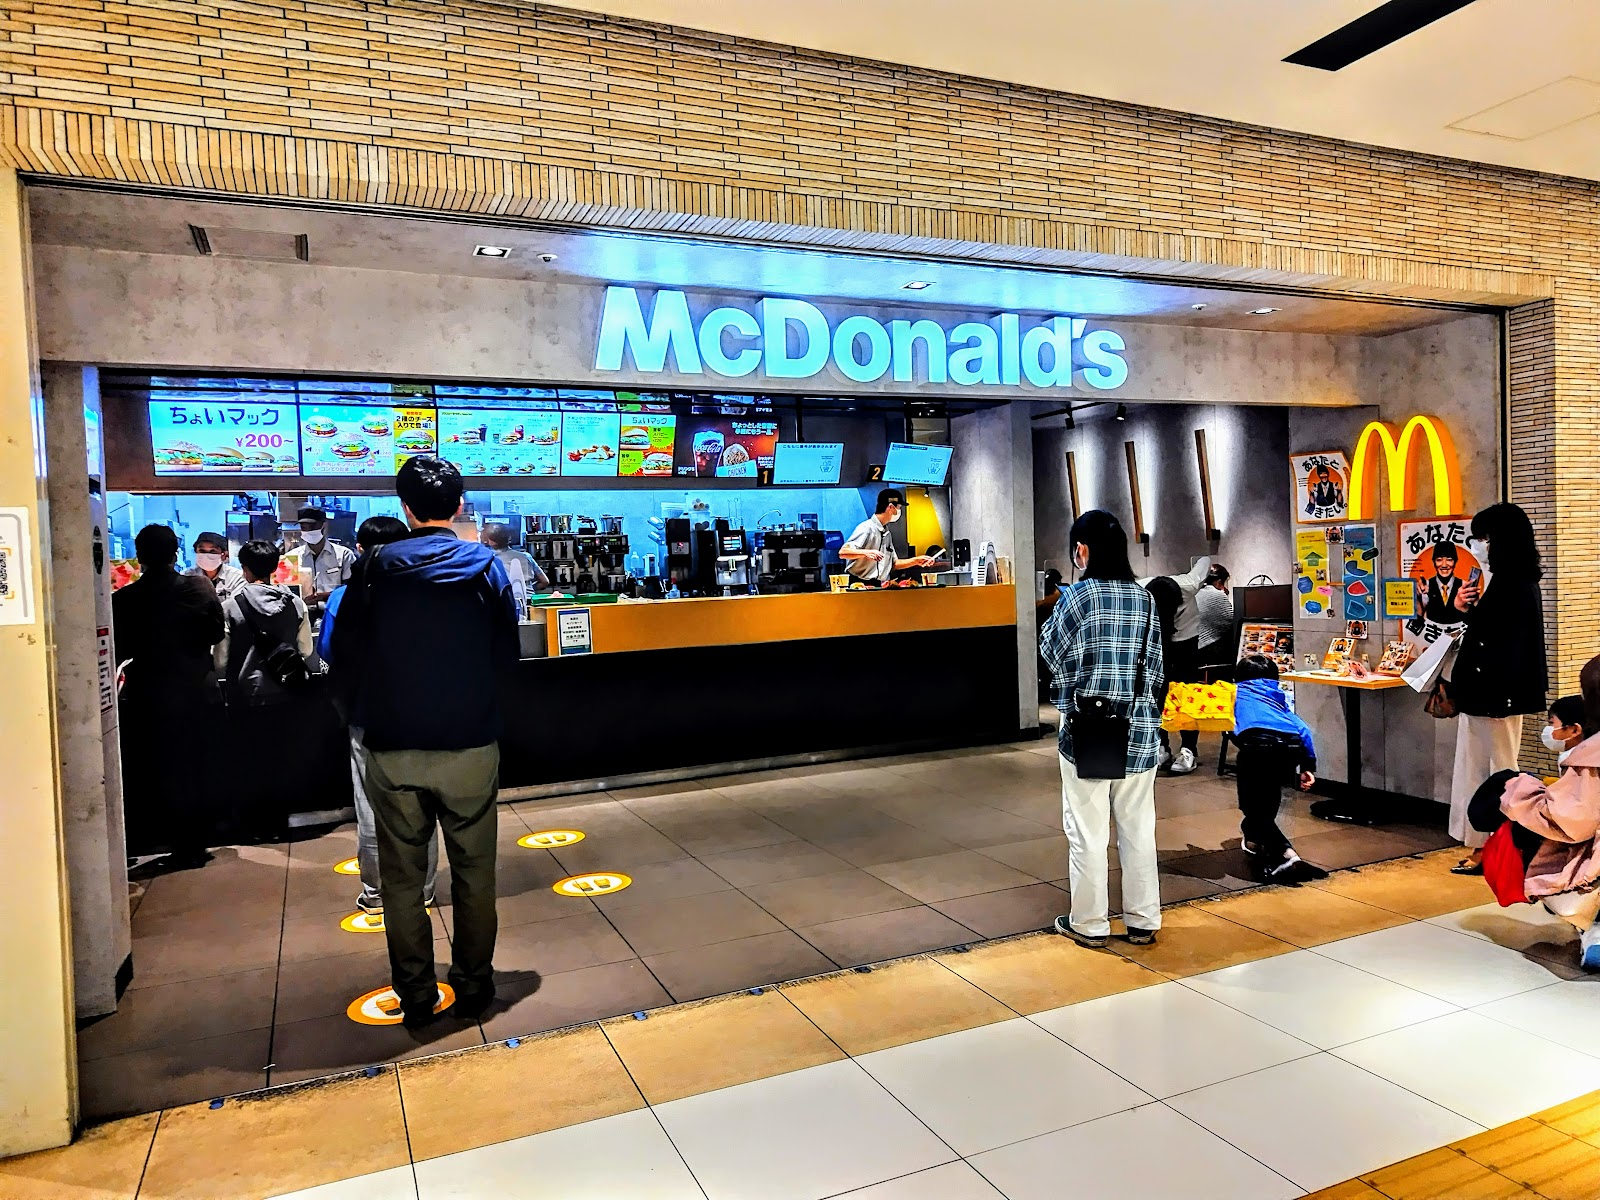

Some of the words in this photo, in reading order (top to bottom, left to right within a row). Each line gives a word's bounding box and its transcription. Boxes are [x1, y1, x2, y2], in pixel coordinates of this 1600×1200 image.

[595, 286, 1129, 390] McDonald's
[169, 406, 280, 426] ちょいマック
[632, 416, 668, 425] ちょいマック
[1302, 455, 1340, 472] あなたと
[762, 470, 769, 485] 1
[871, 466, 882, 481] 2
